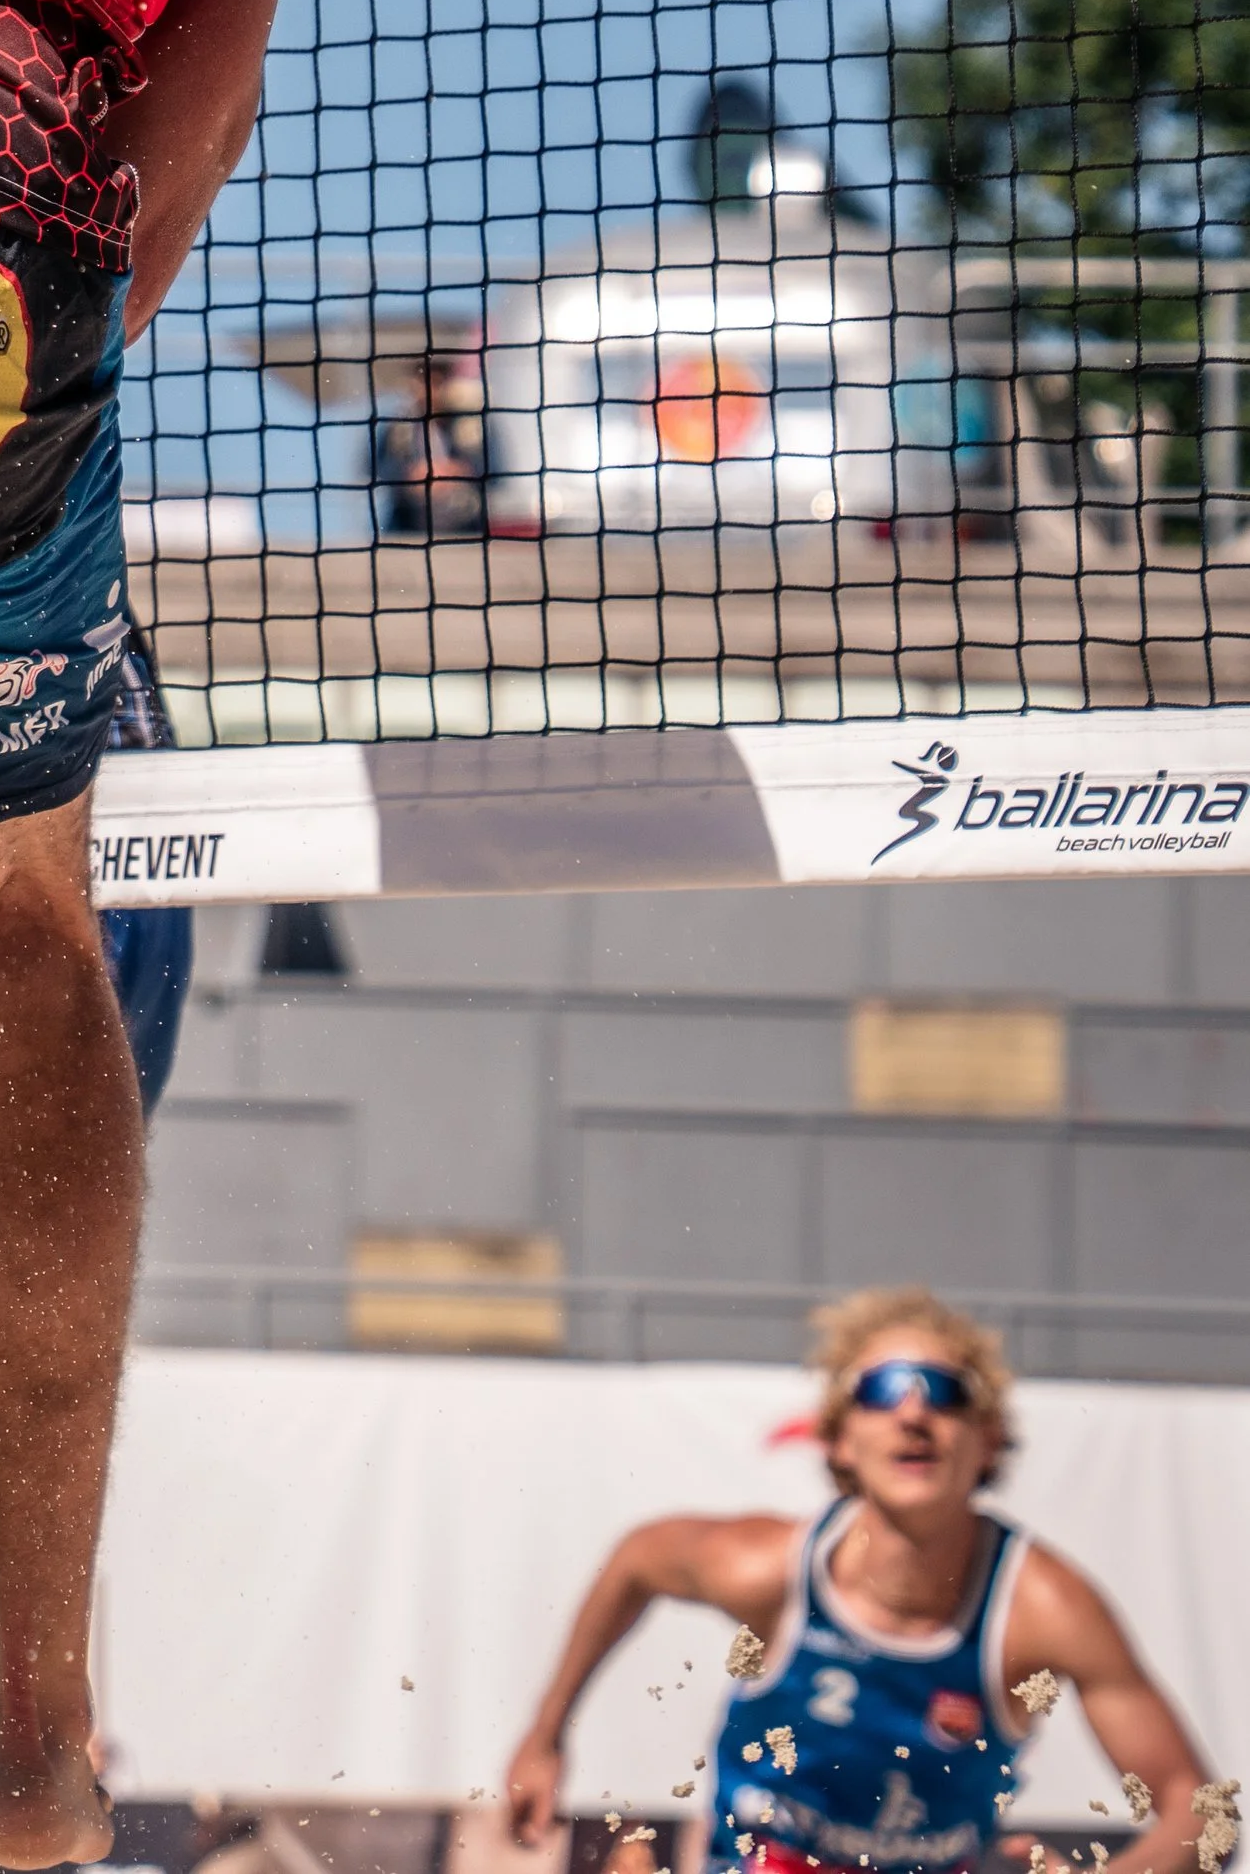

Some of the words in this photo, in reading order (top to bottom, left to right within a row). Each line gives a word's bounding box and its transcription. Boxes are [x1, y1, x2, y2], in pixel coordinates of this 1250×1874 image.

[953, 769, 1250, 832] ballarina
[1056, 834, 1125, 853] beach
[1128, 831, 1233, 854] volleyball
[806, 1667, 859, 1725] 2
